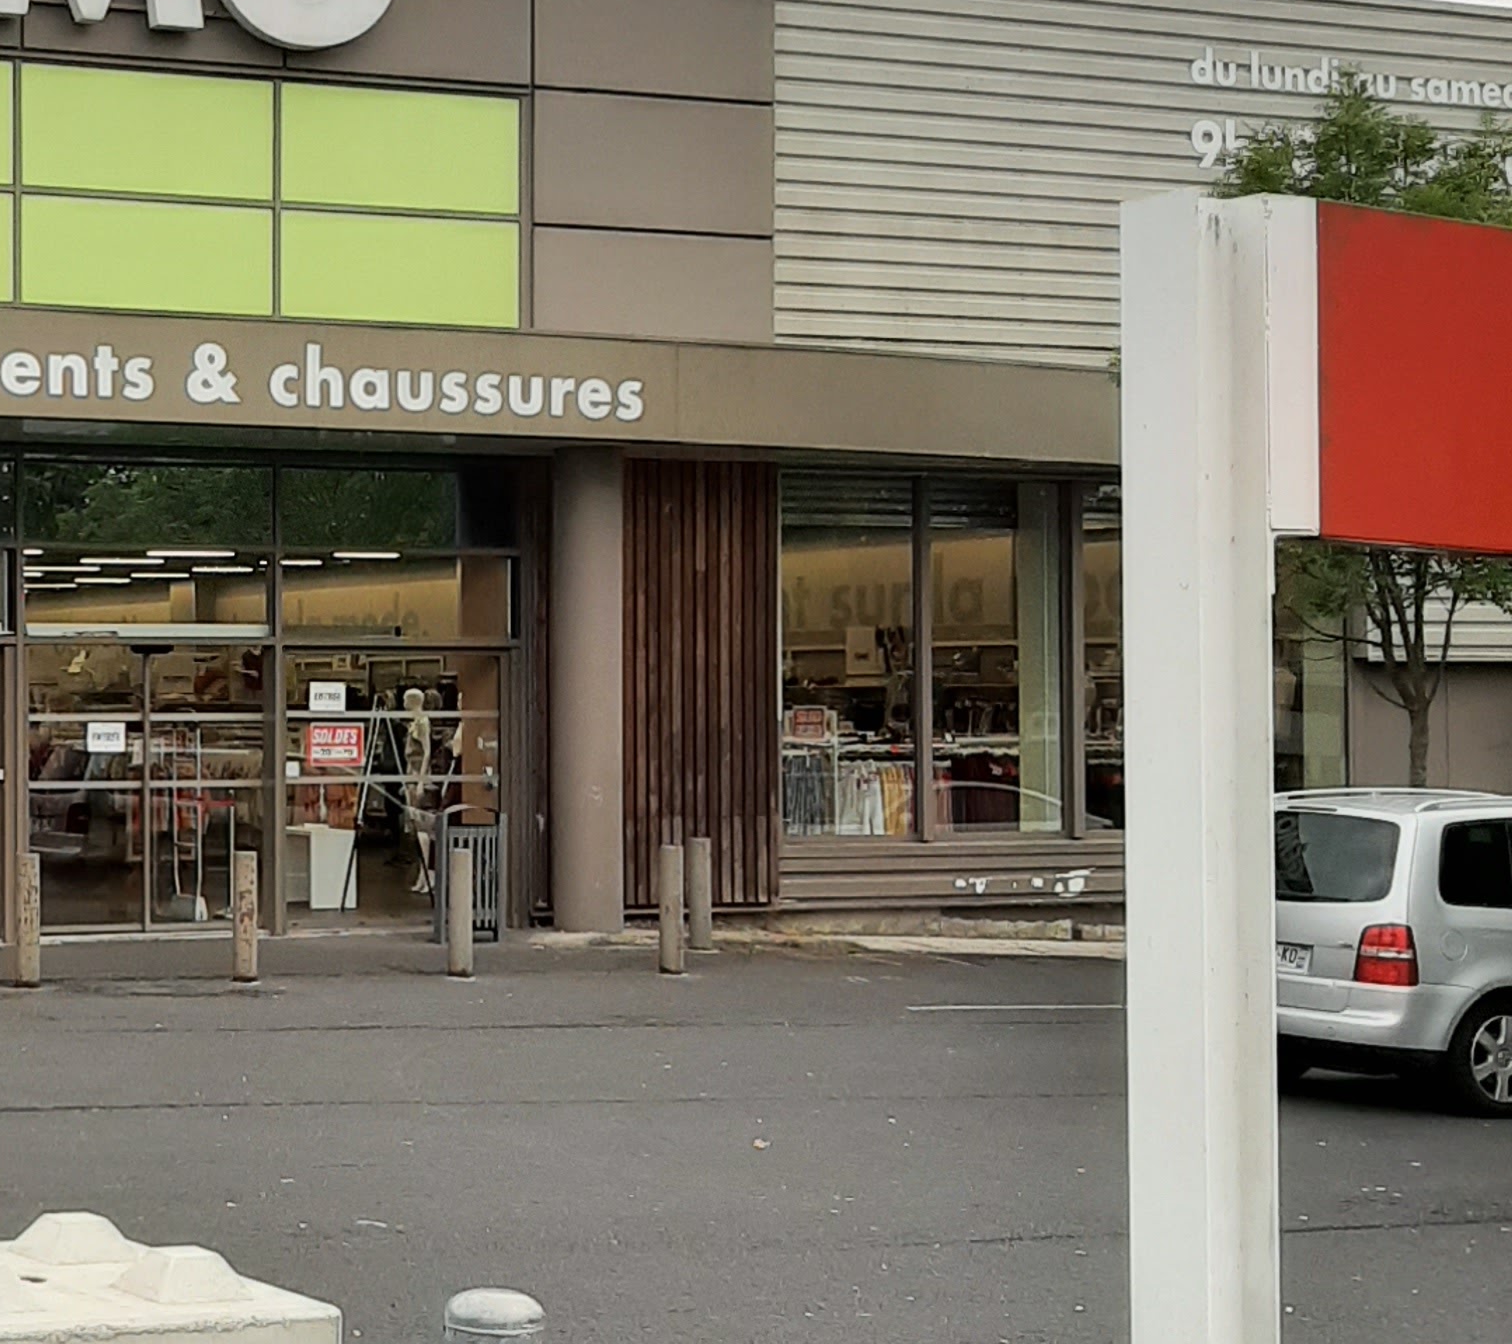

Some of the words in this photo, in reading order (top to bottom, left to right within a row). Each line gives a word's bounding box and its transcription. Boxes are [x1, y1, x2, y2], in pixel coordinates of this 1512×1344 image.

[1190, 46, 1238, 87] du
[1250, 49, 1340, 94] lundi
[186, 342, 241, 404] &
[268, 343, 645, 422] chaussures
